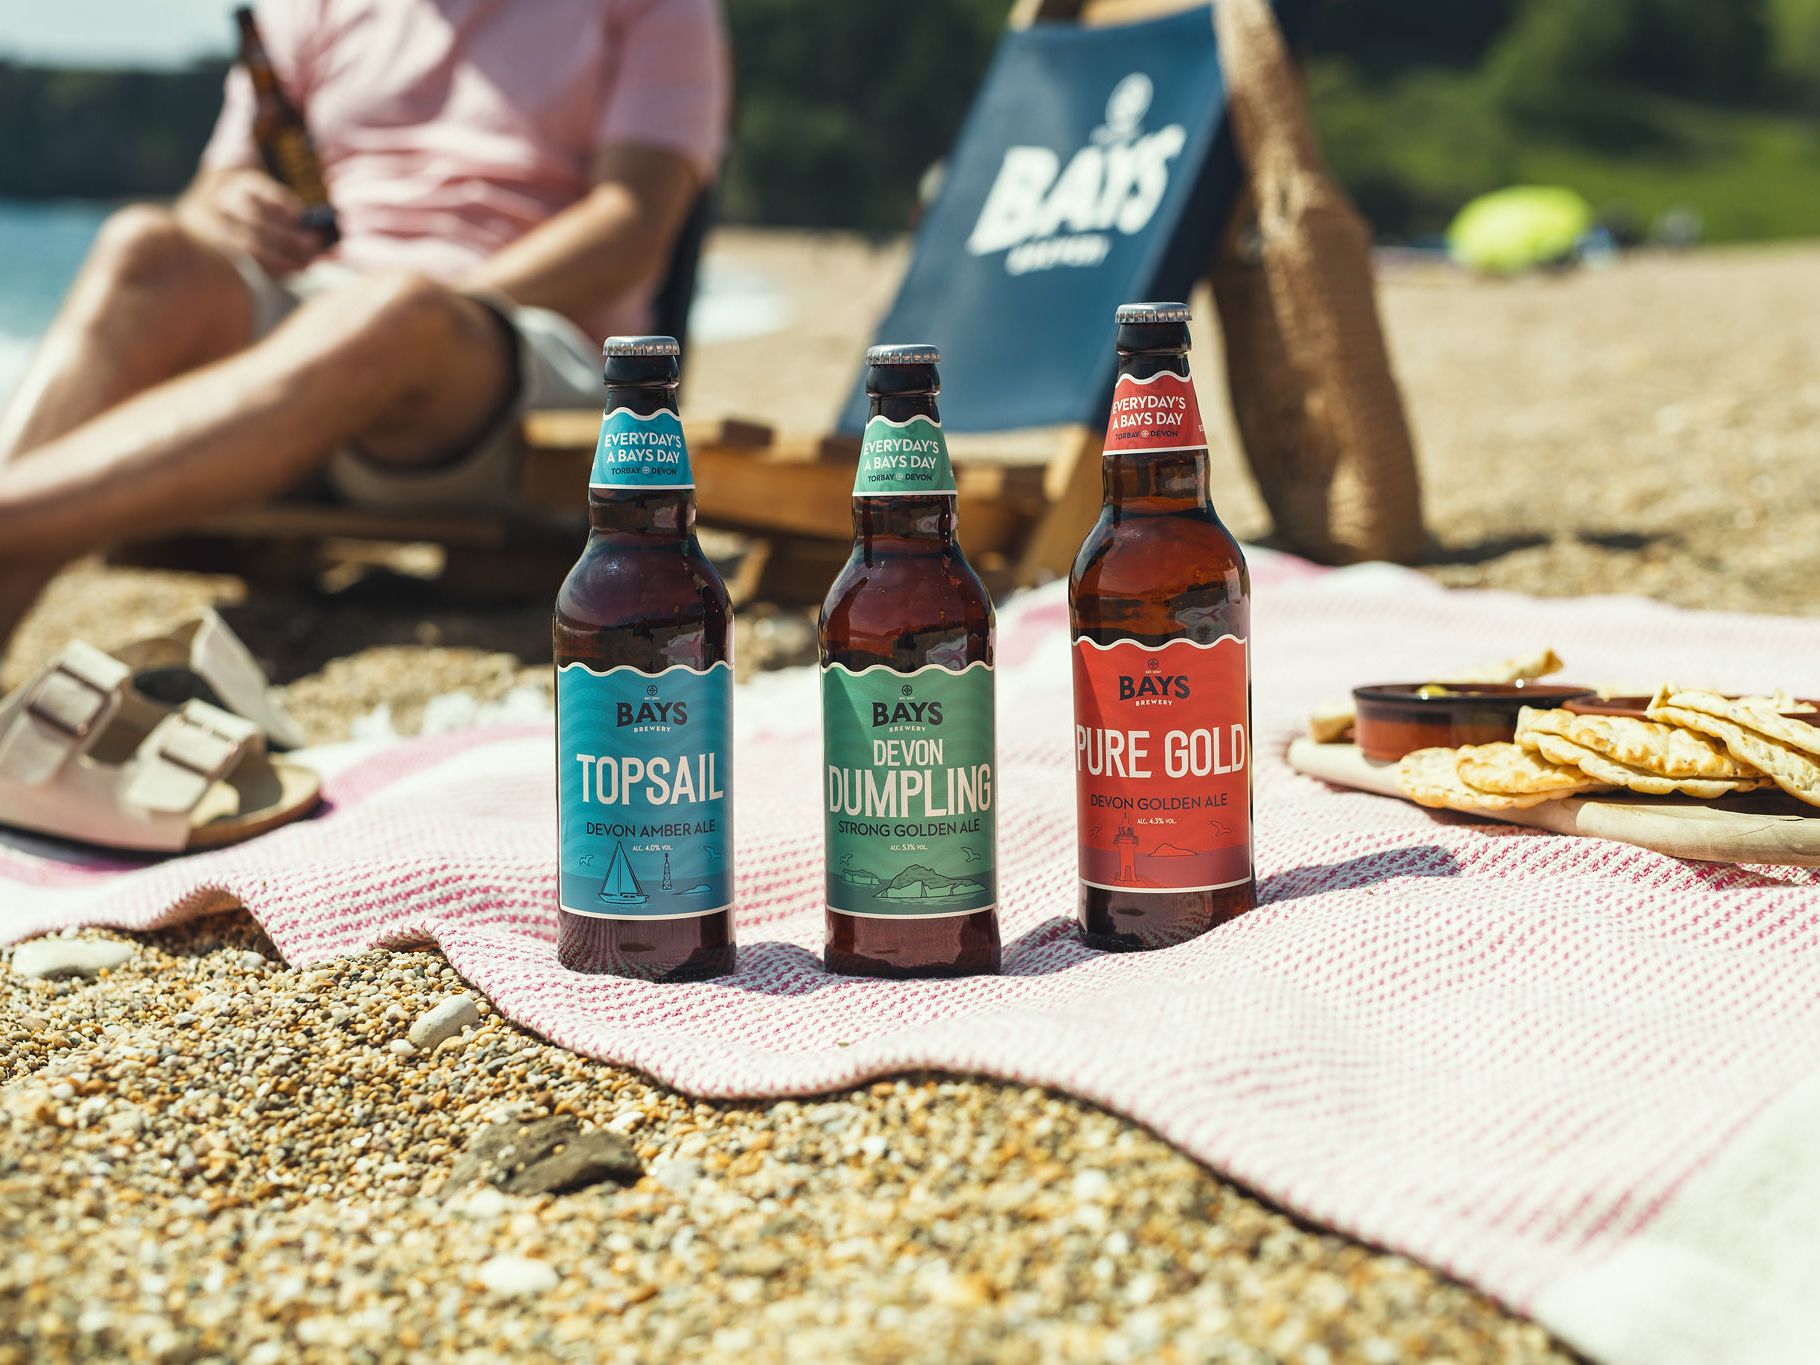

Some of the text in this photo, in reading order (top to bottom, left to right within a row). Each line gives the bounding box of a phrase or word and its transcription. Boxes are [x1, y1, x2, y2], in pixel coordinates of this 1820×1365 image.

[967, 123, 1187, 256] BAYS
[1112, 395, 1186, 415] EVERYDAY'S
[1112, 412, 1183, 430] A BAYS DAY
[604, 432, 682, 448] EVERYDAY'S
[1115, 430, 1178, 440] TORBAY DEVON
[606, 449, 680, 464] A BAYS DAY
[863, 439, 939, 456] EVERYDAY'S
[611, 467, 677, 475] TORBAY DEVON
[864, 456, 937, 471] A BAYS DAY
[868, 473, 933, 482] TORBAY DEVON
[1119, 675, 1190, 701] BAYS
[1135, 699, 1173, 707] BREWERY
[616, 701, 688, 727] BAYS
[872, 701, 944, 727] BAYS
[633, 725, 671, 733] BREWERY
[873, 738, 944, 767] DEVON
[1076, 723, 1245, 778] PURE GOLD
[576, 752, 724, 806] TOPSAIL
[828, 763, 991, 818] DUMPLING
[1091, 793, 1228, 811] DEVON GOLDEN ALE
[586, 818, 716, 838] DEVON AMBER ALE
[838, 818, 981, 837] STRONG GOLDEN ALE
